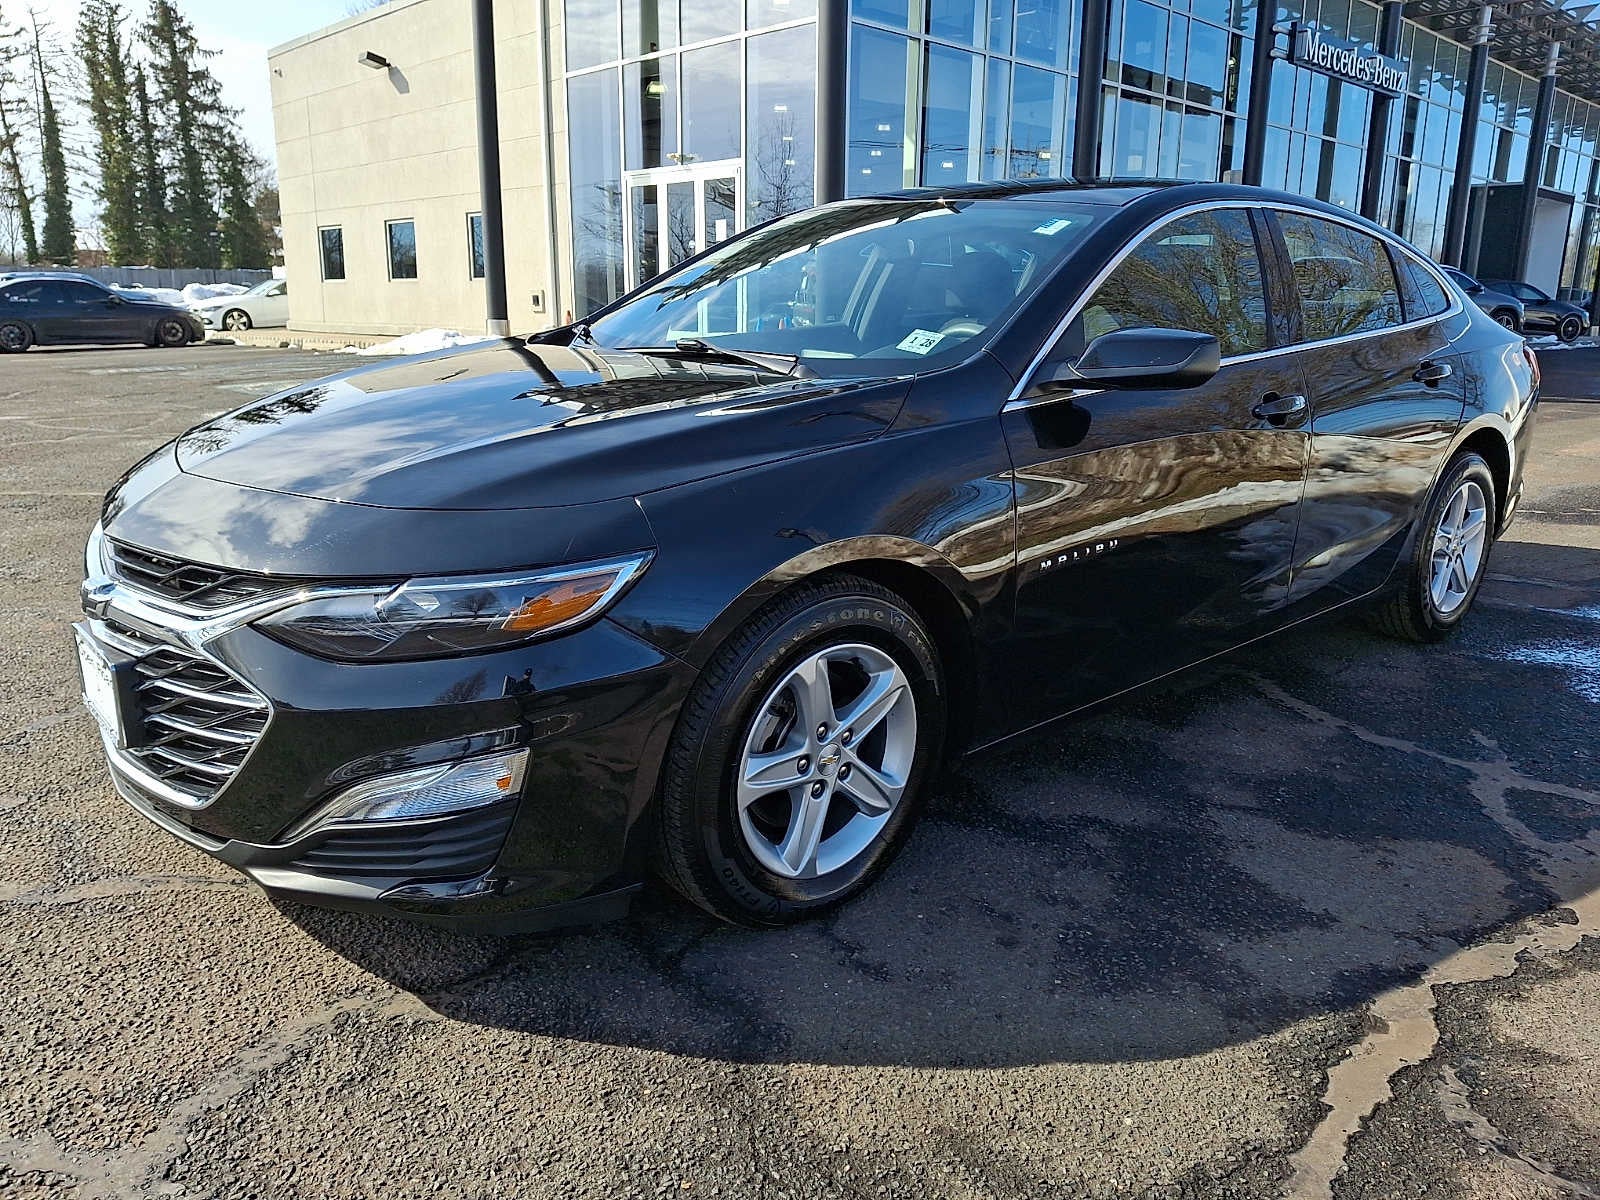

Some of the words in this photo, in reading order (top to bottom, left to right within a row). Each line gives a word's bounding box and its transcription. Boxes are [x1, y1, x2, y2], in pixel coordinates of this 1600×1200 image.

[1304, 28, 1408, 92] Mercedes-Benz
[920, 338, 935, 348] 28
[1040, 539, 1118, 569] MALIBU
